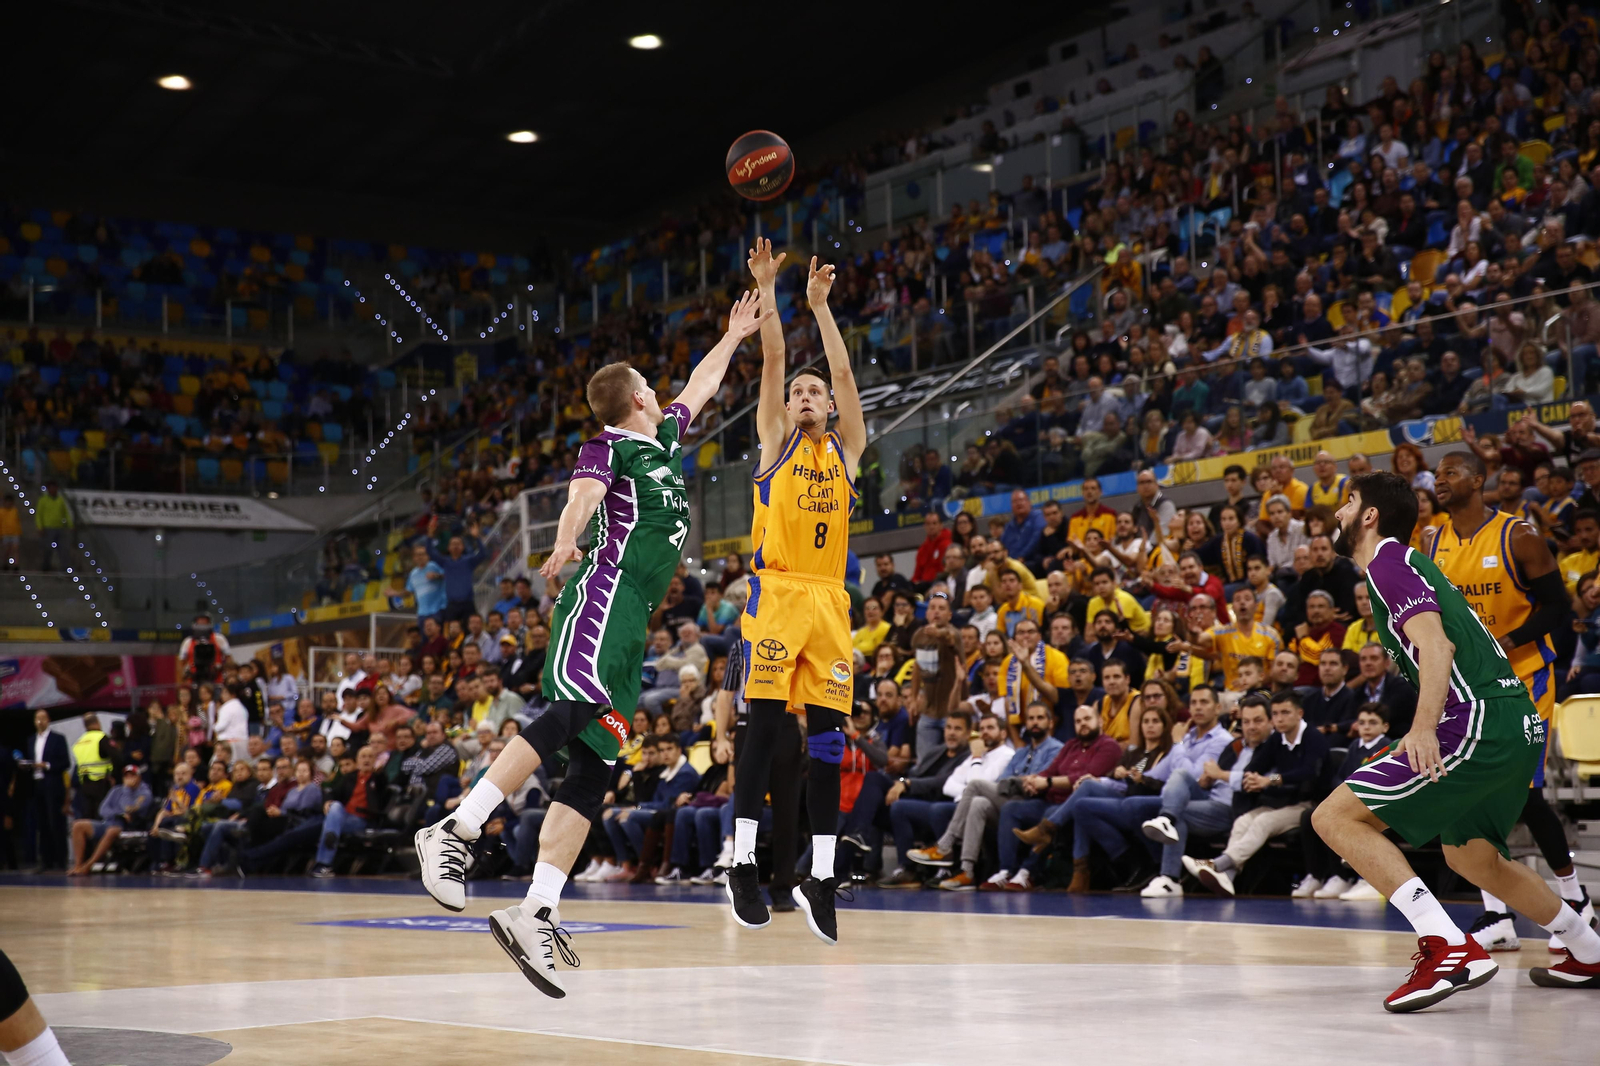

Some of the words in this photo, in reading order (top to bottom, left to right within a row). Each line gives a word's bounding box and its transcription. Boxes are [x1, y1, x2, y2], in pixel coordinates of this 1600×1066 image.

[814, 522, 828, 549] 8
[1393, 591, 1437, 623] ndalucía
[754, 664, 784, 673] TOYOTA
[827, 680, 850, 691] Poema
[1533, 725, 1544, 734] DEL
